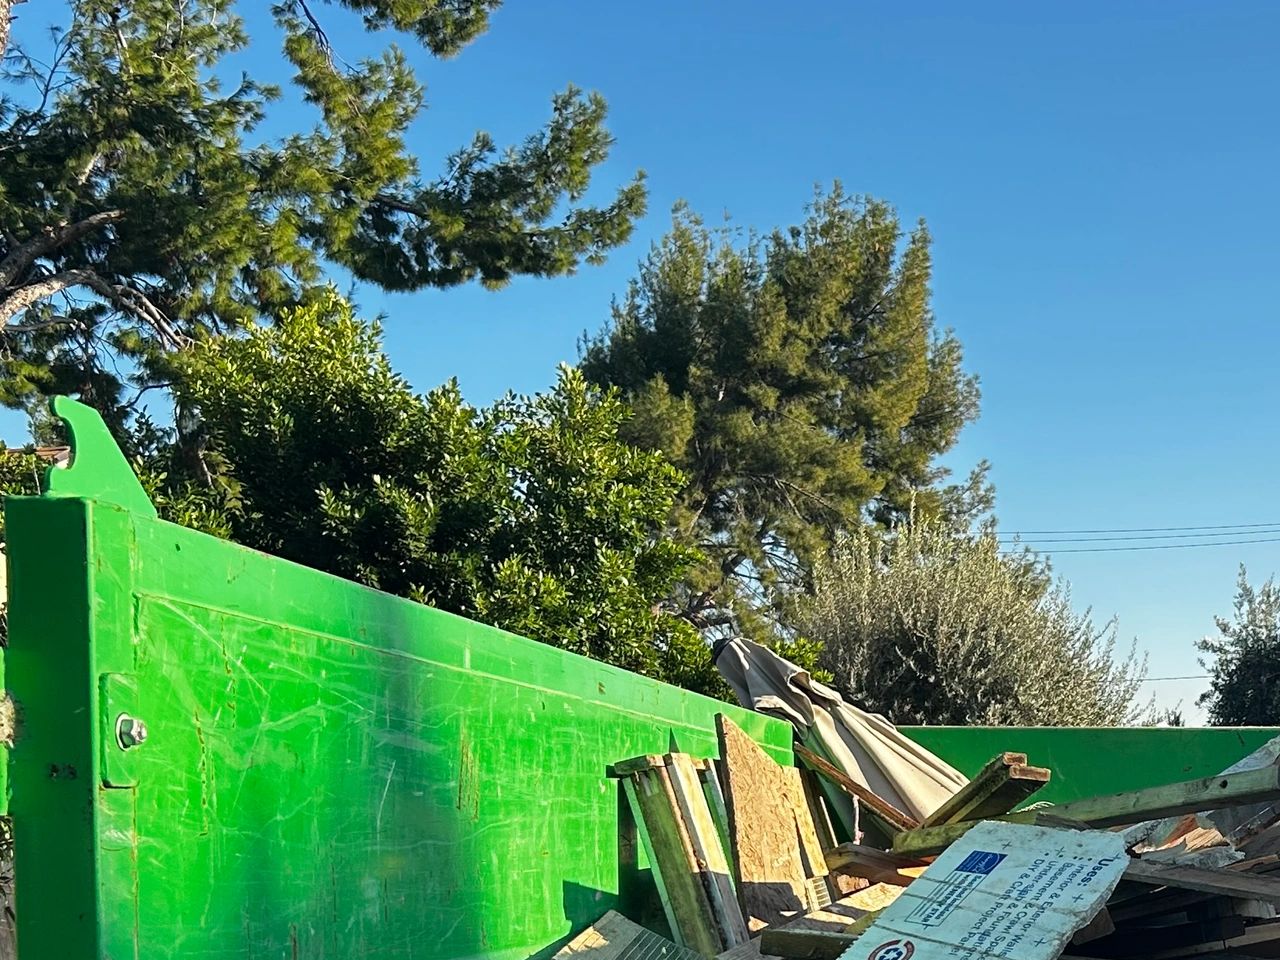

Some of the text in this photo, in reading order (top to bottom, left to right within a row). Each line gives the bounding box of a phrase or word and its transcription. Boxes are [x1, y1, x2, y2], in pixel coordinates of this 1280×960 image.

[1025, 858, 1045, 871] DIY
[1055, 863, 1088, 891] Interior
[1076, 858, 1114, 886] Uses:
[998, 880, 1023, 900] Craft
[1030, 862, 1073, 900] Basement
[969, 901, 1004, 929] Project
[1000, 911, 1028, 933] Crawl
[1018, 901, 1054, 931] Exterior
[946, 931, 976, 955] Panel
[996, 934, 1025, 956] Walls
